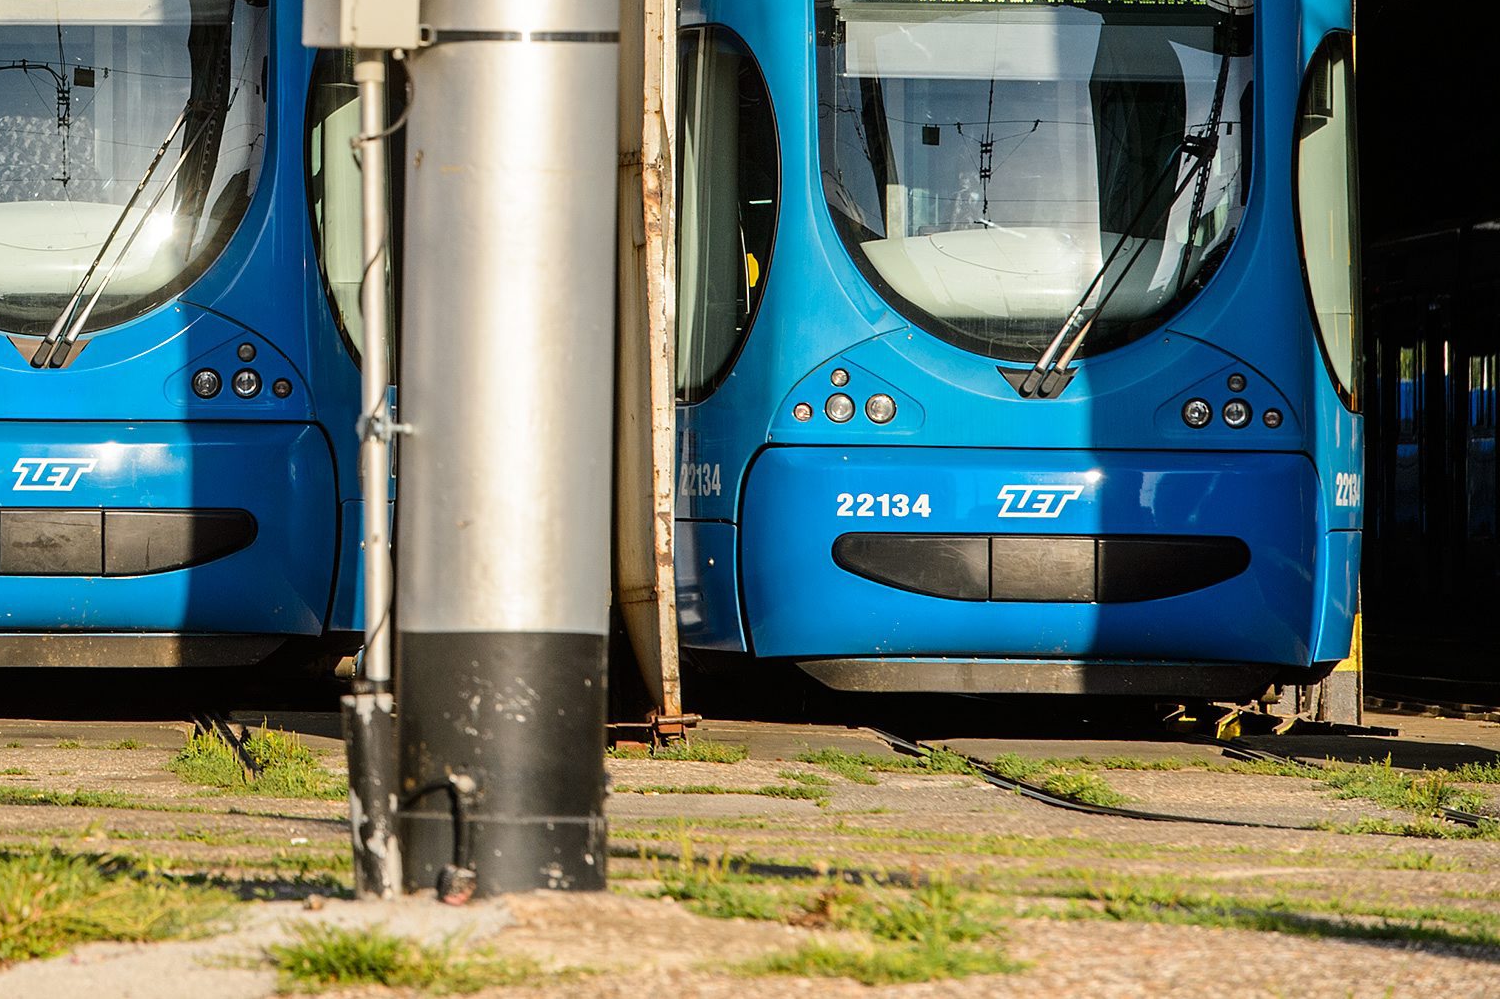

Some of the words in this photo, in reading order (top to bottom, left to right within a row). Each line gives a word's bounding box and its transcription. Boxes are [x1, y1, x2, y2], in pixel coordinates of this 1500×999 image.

[12, 457, 100, 492] ZET
[680, 463, 722, 497] 22134
[836, 492, 932, 518] 22134
[997, 484, 1085, 518] ZET
